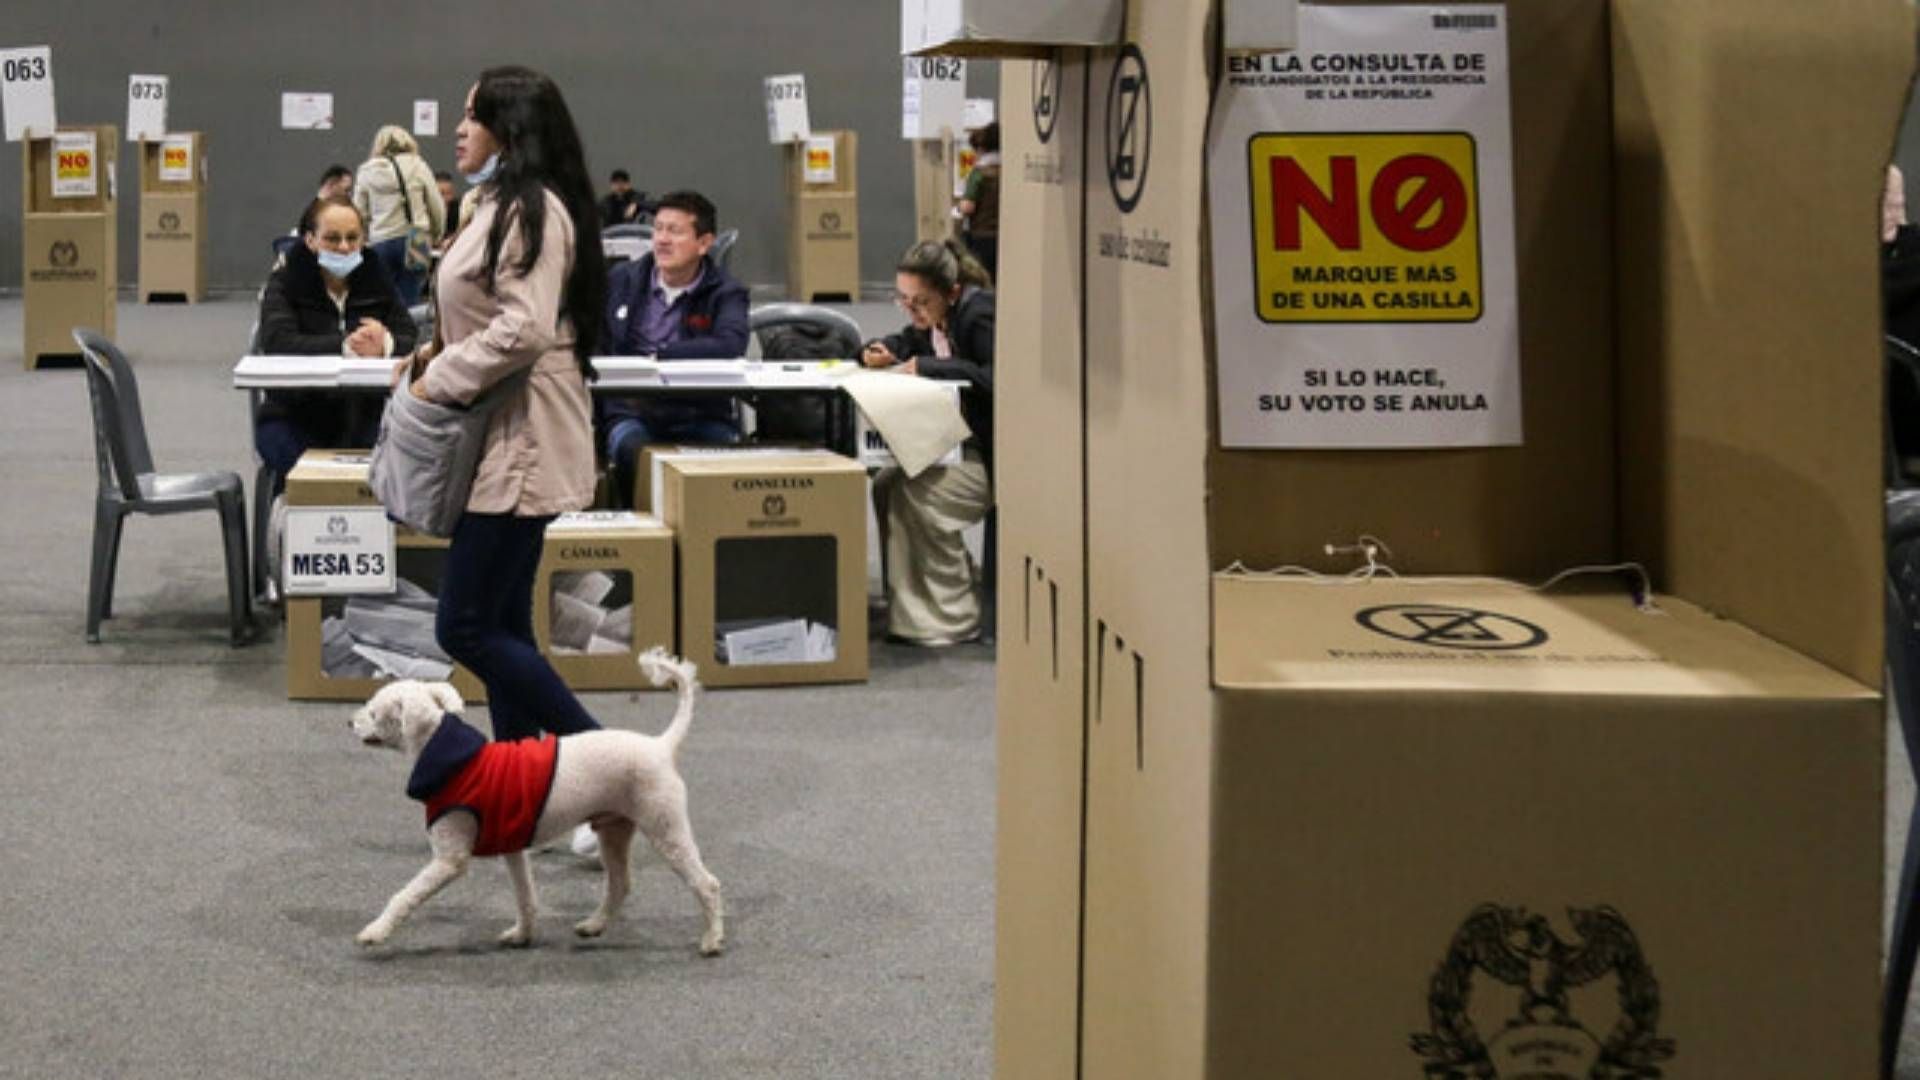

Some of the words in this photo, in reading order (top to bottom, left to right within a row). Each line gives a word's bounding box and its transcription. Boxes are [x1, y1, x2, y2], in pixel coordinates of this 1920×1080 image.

[4, 57, 46, 81] 063
[921, 58, 962, 80] 062
[1229, 55, 1261, 72] EN
[1272, 55, 1302, 72] LA
[1311, 54, 1445, 72] CONSULTA
[1454, 53, 1485, 71] DE
[1229, 74, 1350, 86] PRECANDIDATOS
[1356, 75, 1365, 85] A
[1369, 75, 1387, 85] LA
[1392, 75, 1485, 85] PRESIDENCIA
[132, 83, 163, 99] 073
[1305, 89, 1325, 99] DE
[1329, 89, 1347, 99] LA
[59, 153, 89, 169] NO
[165, 149, 187, 161] NO
[1269, 154, 1469, 253] NO
[1293, 266, 1397, 284] MARQUE
[1406, 261, 1457, 284] MÁS
[1272, 292, 1305, 309] DE
[1313, 292, 1366, 309] UNA
[1372, 291, 1473, 309] CASILLA
[1304, 370, 1327, 387] SI
[1335, 370, 1367, 387] LO
[1374, 369, 1446, 389] HACE,
[1259, 395, 1291, 412] SU
[1301, 395, 1366, 412] VOTO
[1373, 395, 1404, 411] SE
[1410, 394, 1489, 411] ANULA
[733, 477, 815, 491] CONSULTAS
[292, 553, 351, 576] MESA
[356, 553, 385, 576] 53
